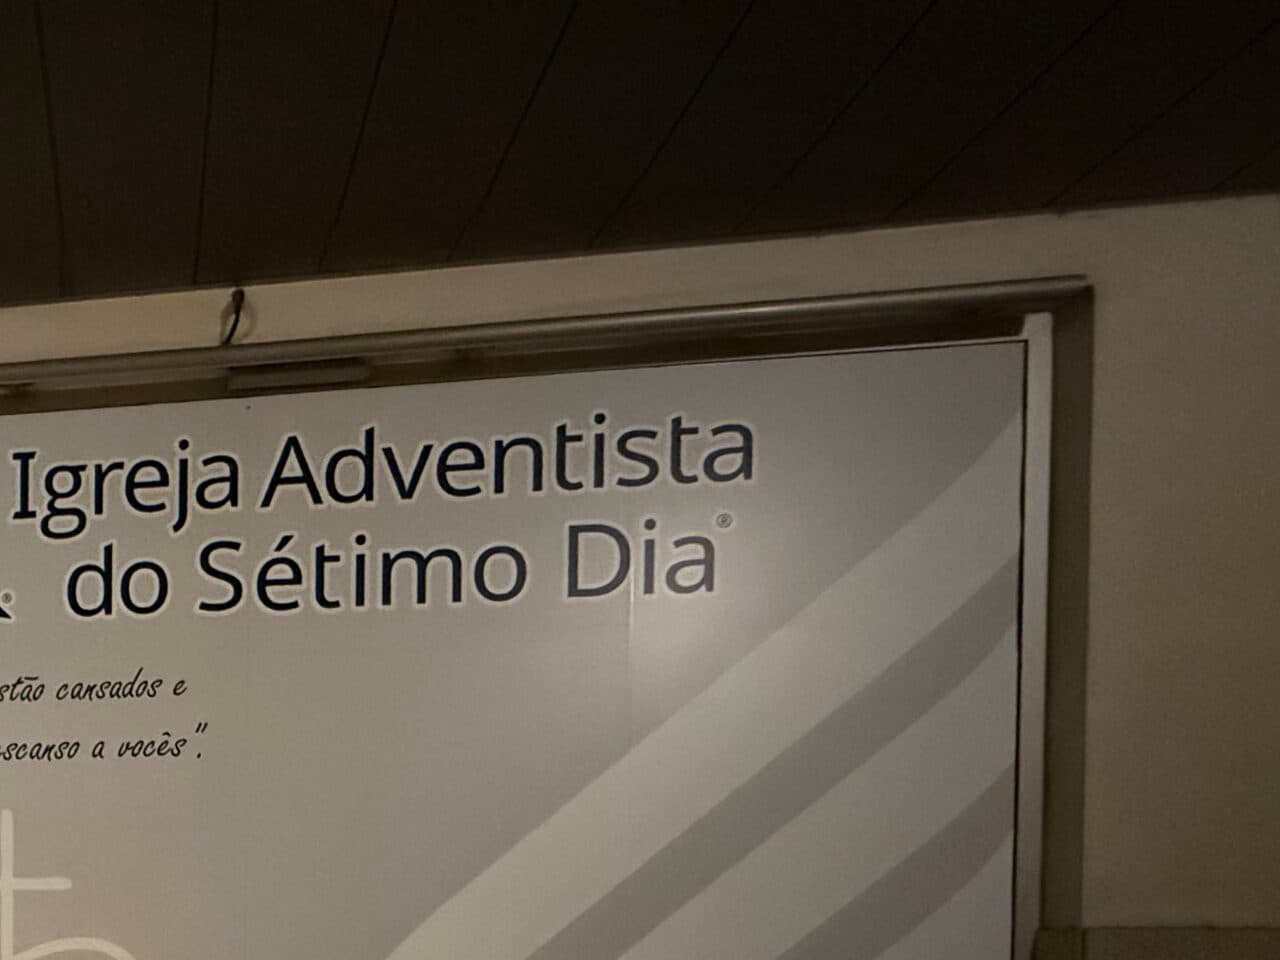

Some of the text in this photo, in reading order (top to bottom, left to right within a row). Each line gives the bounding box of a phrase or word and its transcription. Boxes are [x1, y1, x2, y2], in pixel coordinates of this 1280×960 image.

[12, 412, 753, 540] Igreja Adventista
[67, 543, 169, 618] do
[198, 533, 527, 612] Sétimo
[55, 666, 164, 702] cansados
[172, 679, 188, 697] e
[91, 740, 105, 759] a
